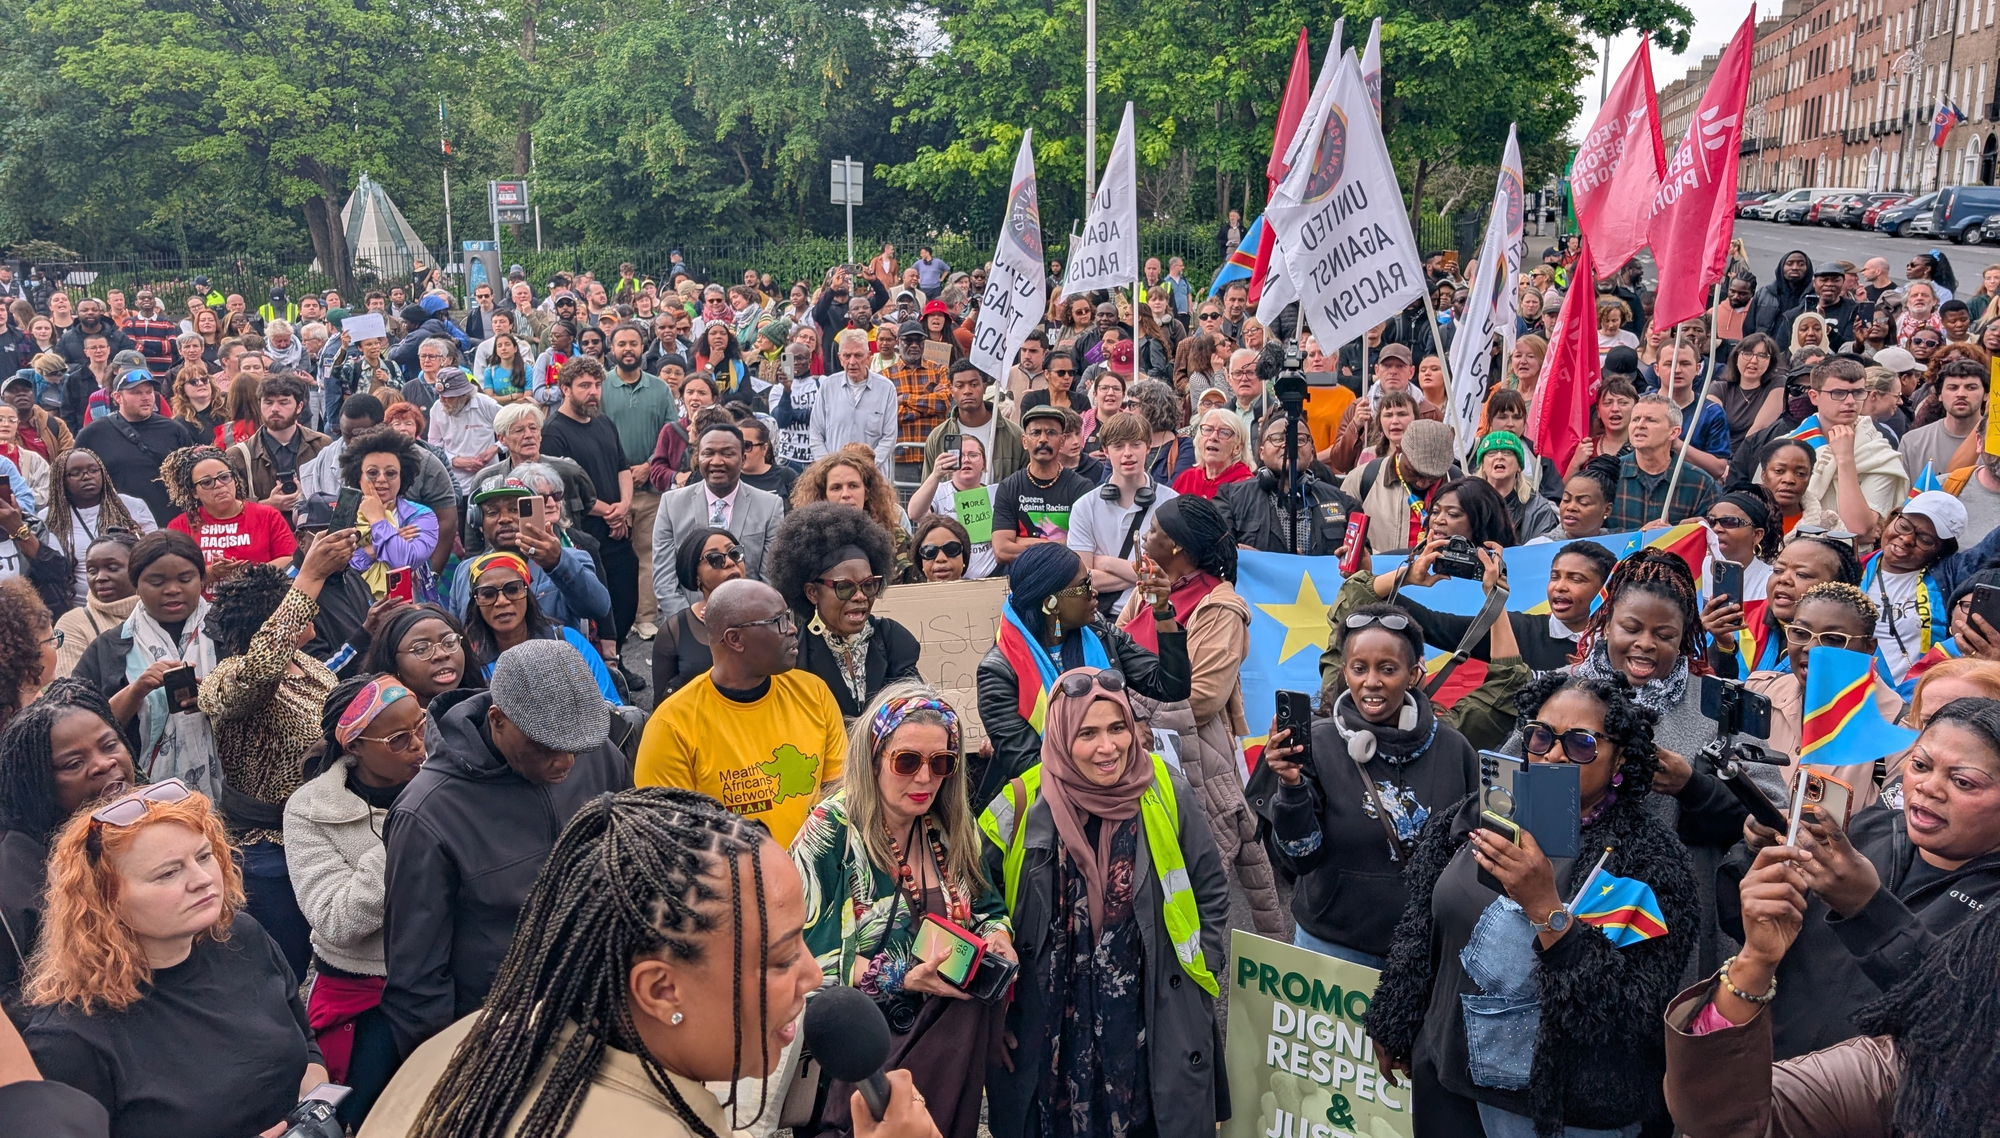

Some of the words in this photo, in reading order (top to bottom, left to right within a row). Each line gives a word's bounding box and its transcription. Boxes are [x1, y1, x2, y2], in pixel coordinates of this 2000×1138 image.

[961, 498, 985, 510] MORE
[1018, 495, 1044, 504] Queers
[1018, 503, 1045, 512] Against
[1046, 503, 1070, 512] Racism
[200, 522, 238, 535] SHOW
[200, 533, 251, 548] RACISM
[934, 661, 974, 694] fo
[719, 765, 760, 783] Meath
[722, 776, 773, 794] Africans
[722, 786, 777, 805] Network
[1949, 890, 1985, 911] GUES
[1237, 956, 1373, 1025] PROMO
[1272, 1000, 1374, 1063] DIGNI
[1326, 1093, 1357, 1134] &
